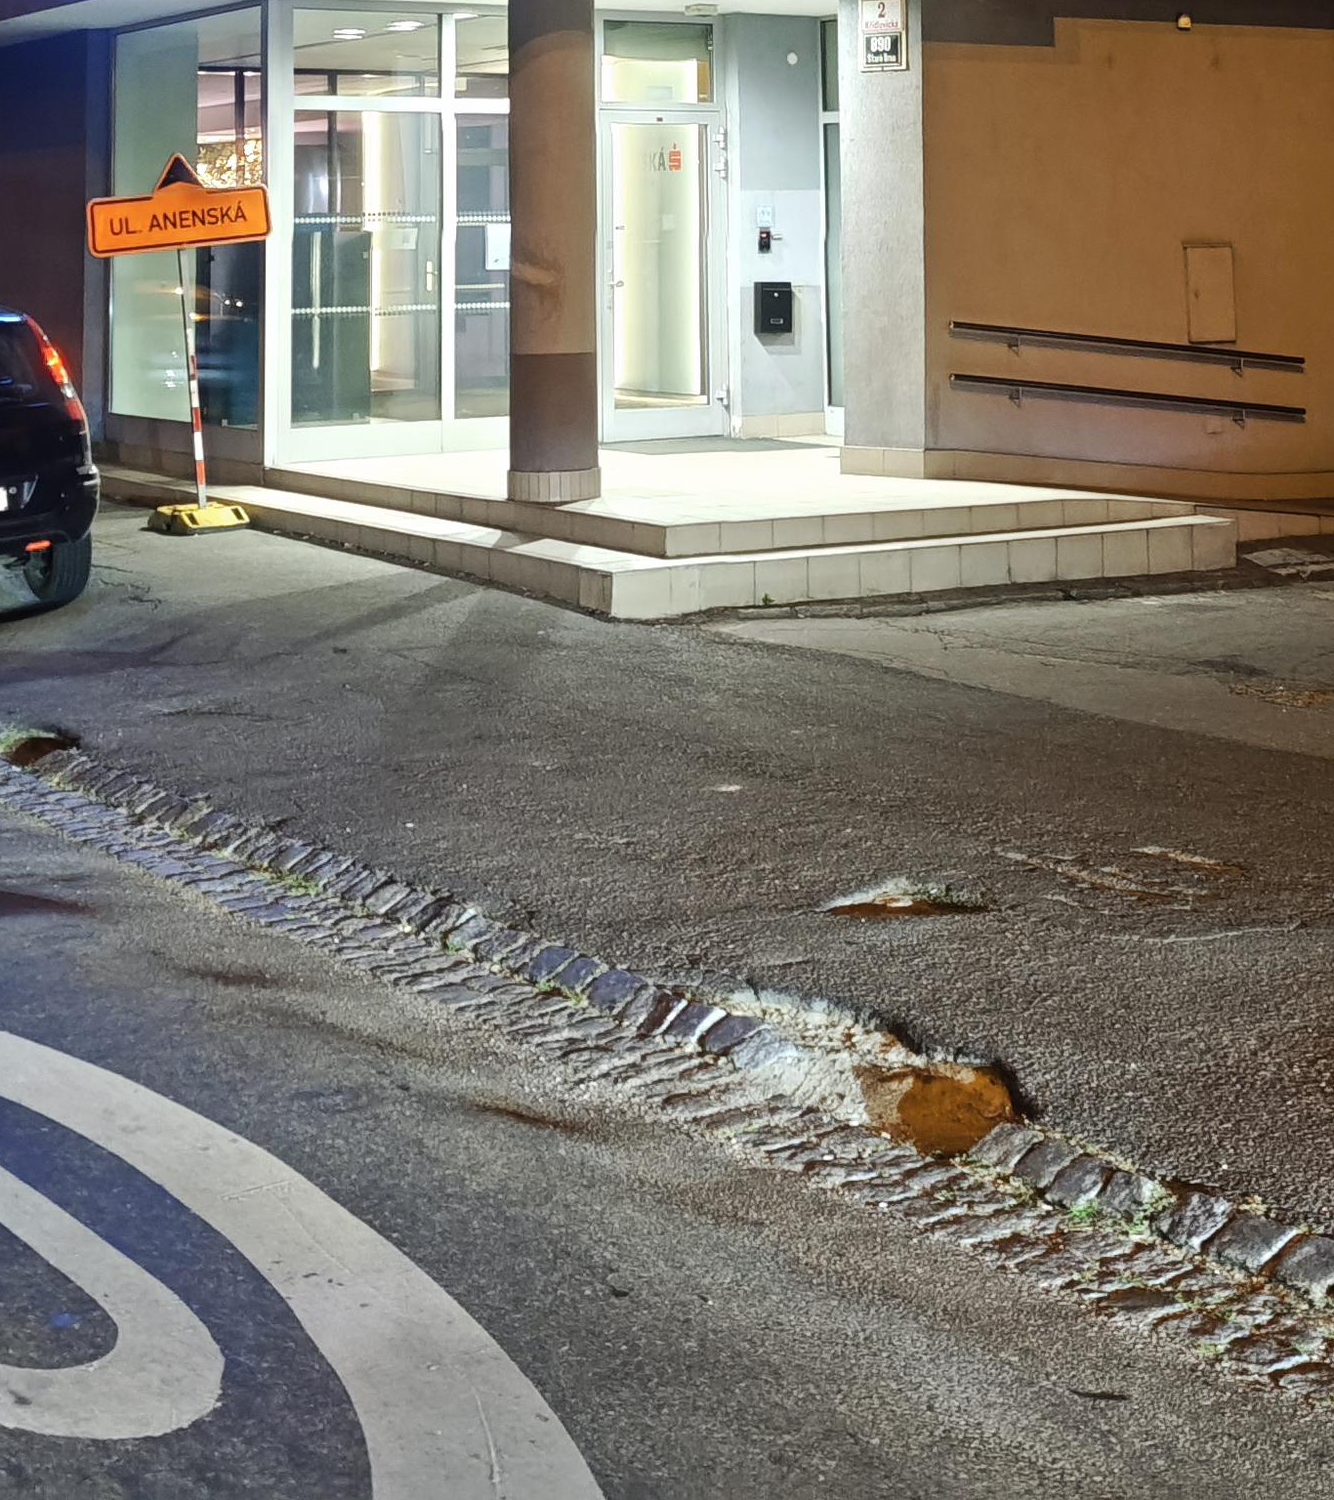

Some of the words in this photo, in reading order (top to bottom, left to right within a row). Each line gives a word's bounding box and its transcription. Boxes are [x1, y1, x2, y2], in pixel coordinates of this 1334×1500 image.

[877, 1, 886, 18] 2
[870, 35, 892, 53] 890
[149, 200, 248, 233] ANENSKÁ
